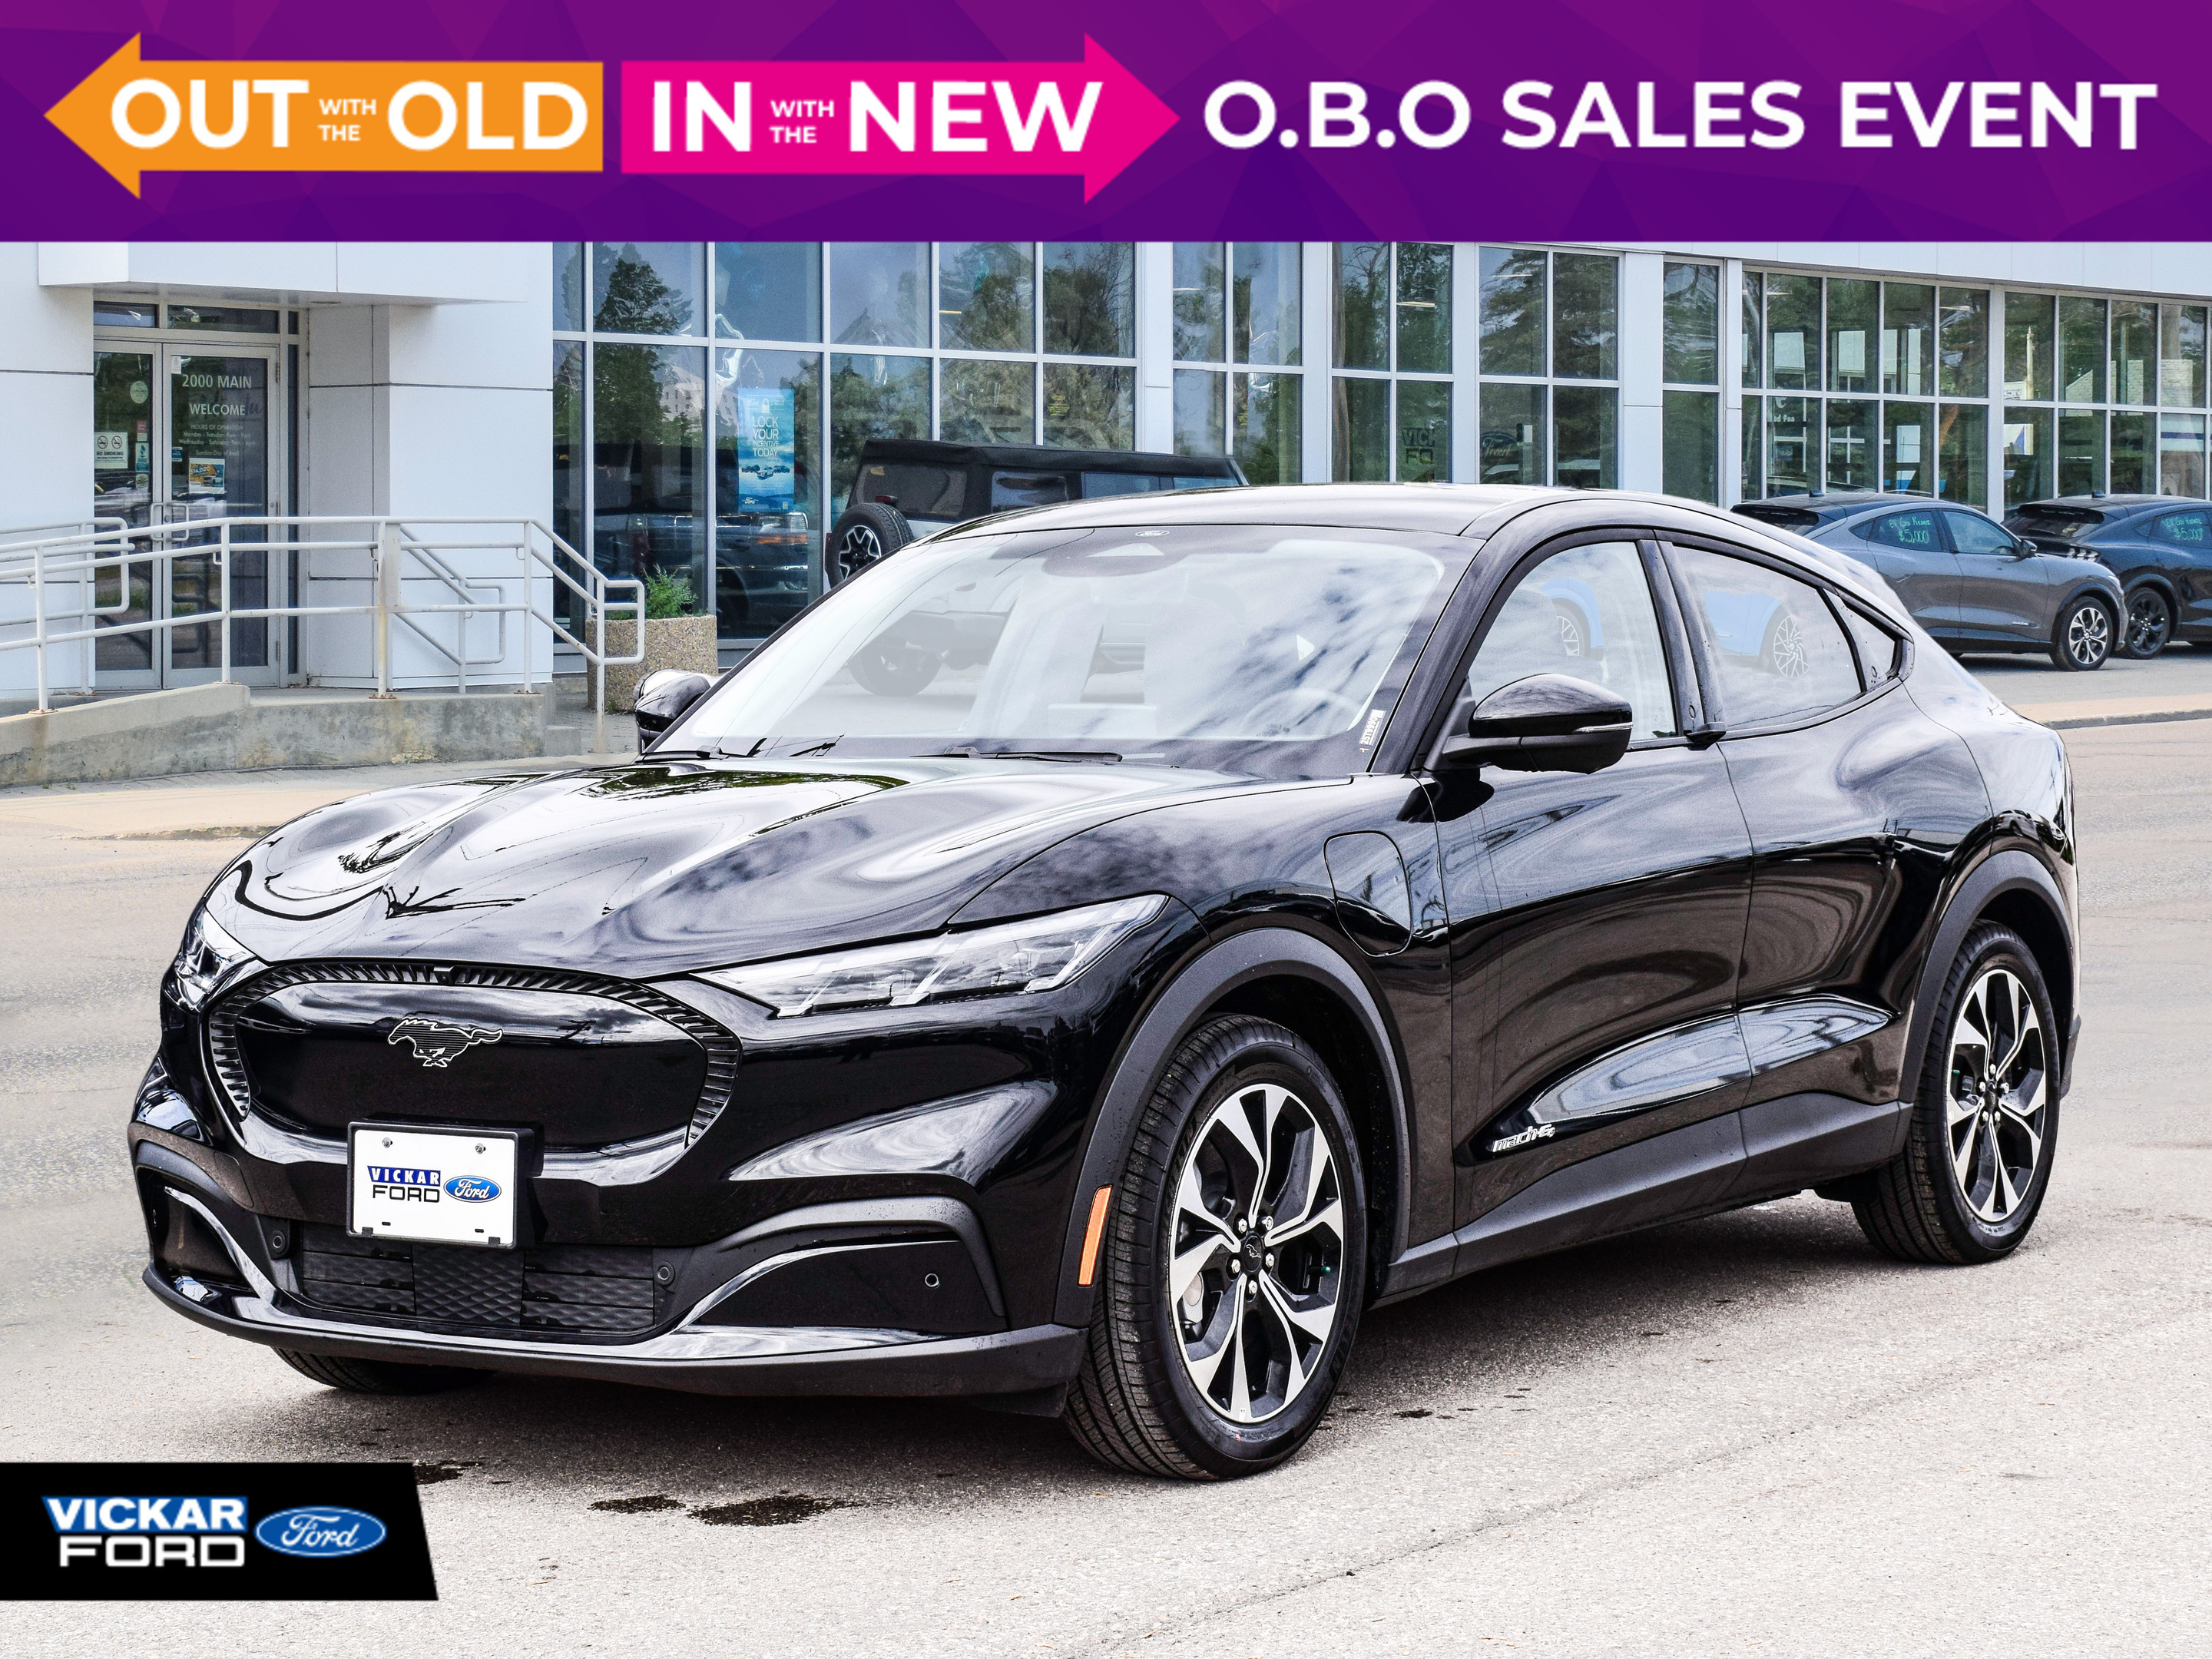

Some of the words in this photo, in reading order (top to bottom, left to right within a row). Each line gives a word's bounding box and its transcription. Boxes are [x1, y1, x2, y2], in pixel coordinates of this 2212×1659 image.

[182, 374, 213, 387] 2000
[217, 375, 252, 389] MAIN
[189, 403, 246, 416] WELCOME
[753, 416, 779, 428] LOCK
[752, 429, 780, 440] YOUR
[753, 448, 779, 457] TODAY
[1899, 528, 1929, 544] $5,000
[370, 1167, 441, 1186] VICKAR
[373, 1184, 440, 1204] FORD
[455, 1178, 490, 1199] Ford
